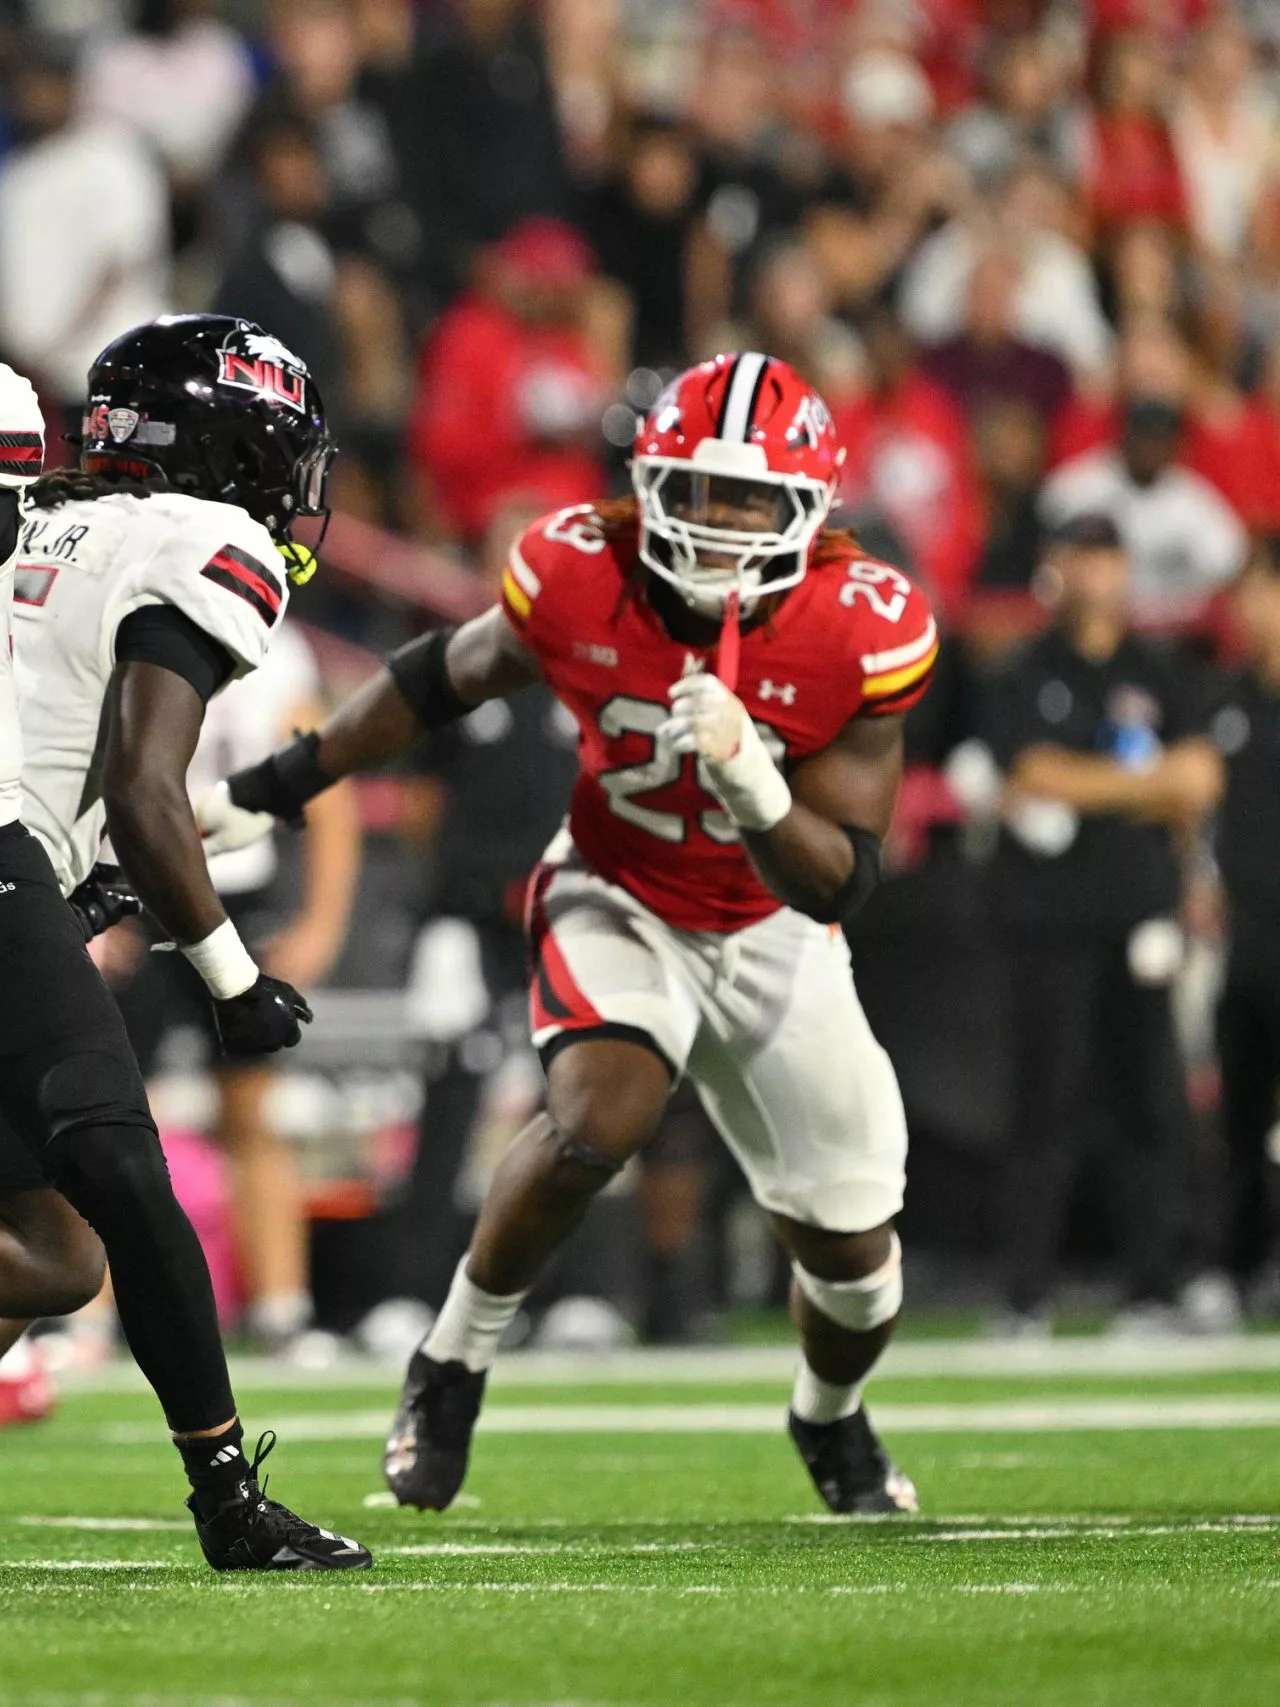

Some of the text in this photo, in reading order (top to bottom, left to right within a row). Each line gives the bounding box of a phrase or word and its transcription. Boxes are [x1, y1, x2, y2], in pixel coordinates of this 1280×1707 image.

[223, 353, 303, 405] NIU
[43, 524, 90, 562] JR.
[839, 560, 912, 624] 29
